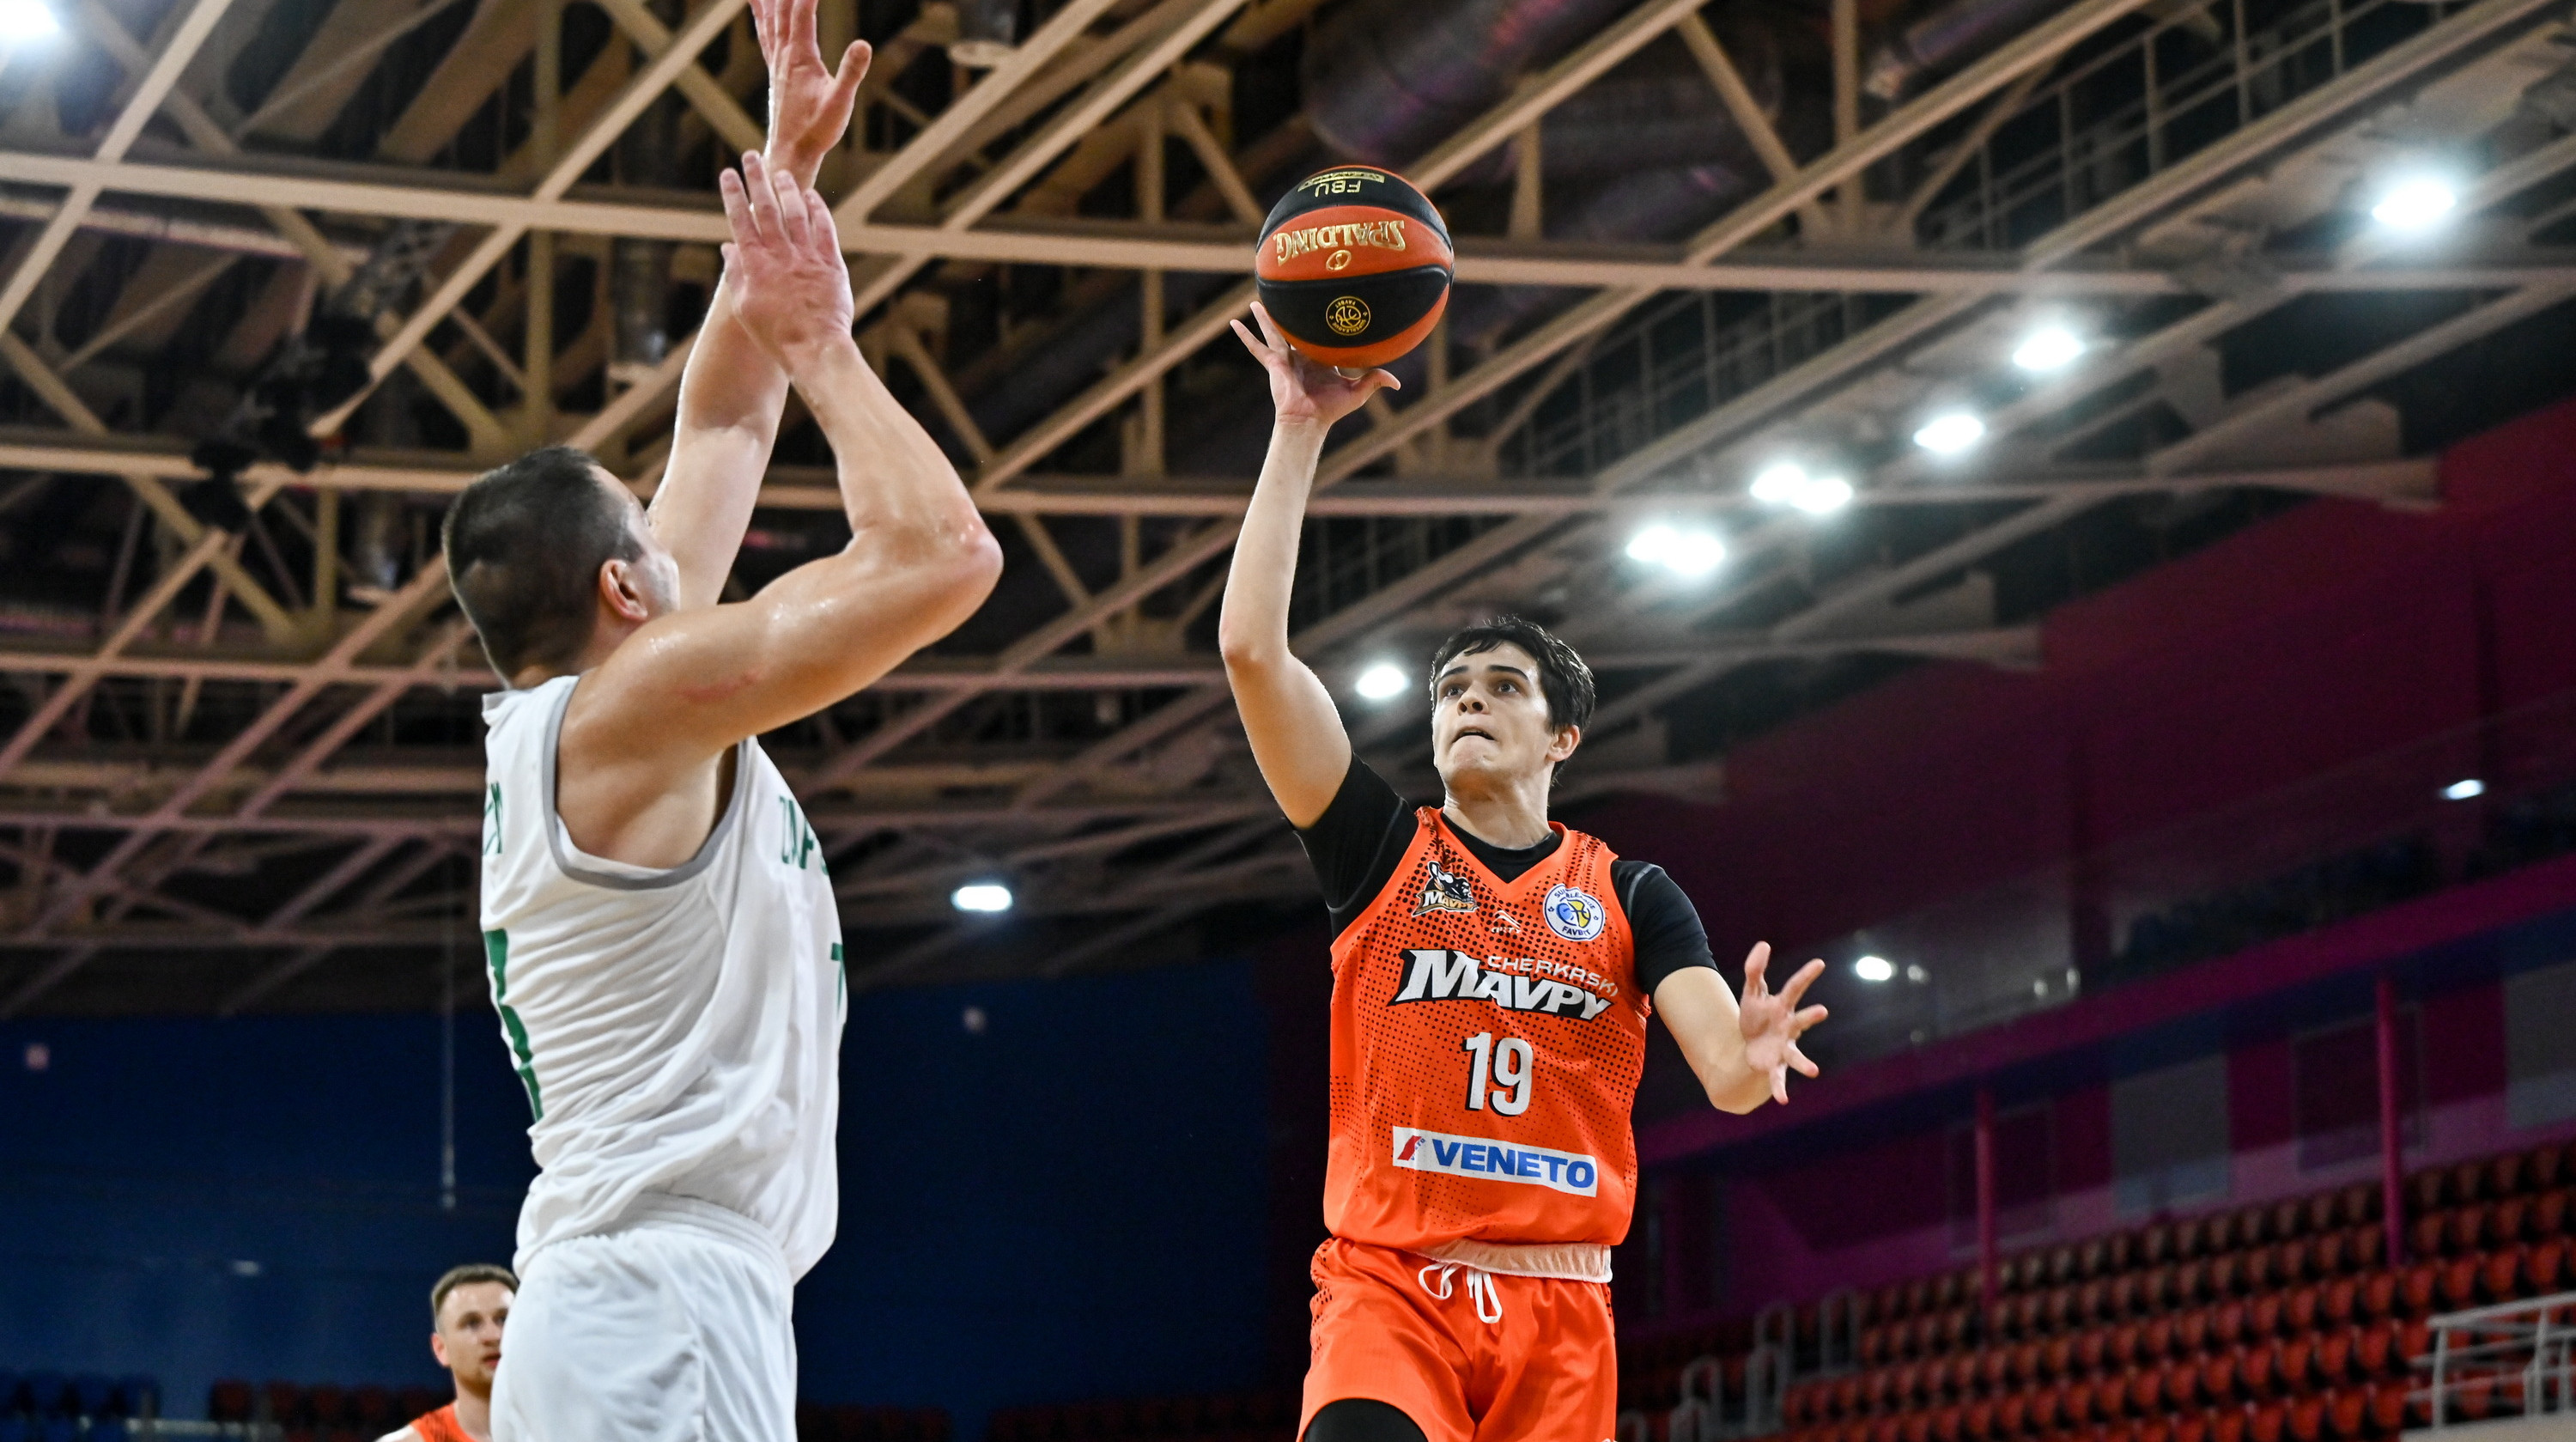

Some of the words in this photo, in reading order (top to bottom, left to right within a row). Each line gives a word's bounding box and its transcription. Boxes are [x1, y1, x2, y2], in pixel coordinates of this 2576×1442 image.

[1315, 179, 1362, 198] FBU
[1274, 220, 1406, 267] SPALDING
[1421, 891, 1475, 909] MAVPY
[1394, 949, 1613, 1020] MAVPY
[1463, 1031, 1534, 1117] 19
[1431, 1138, 1595, 1189] VENETO
